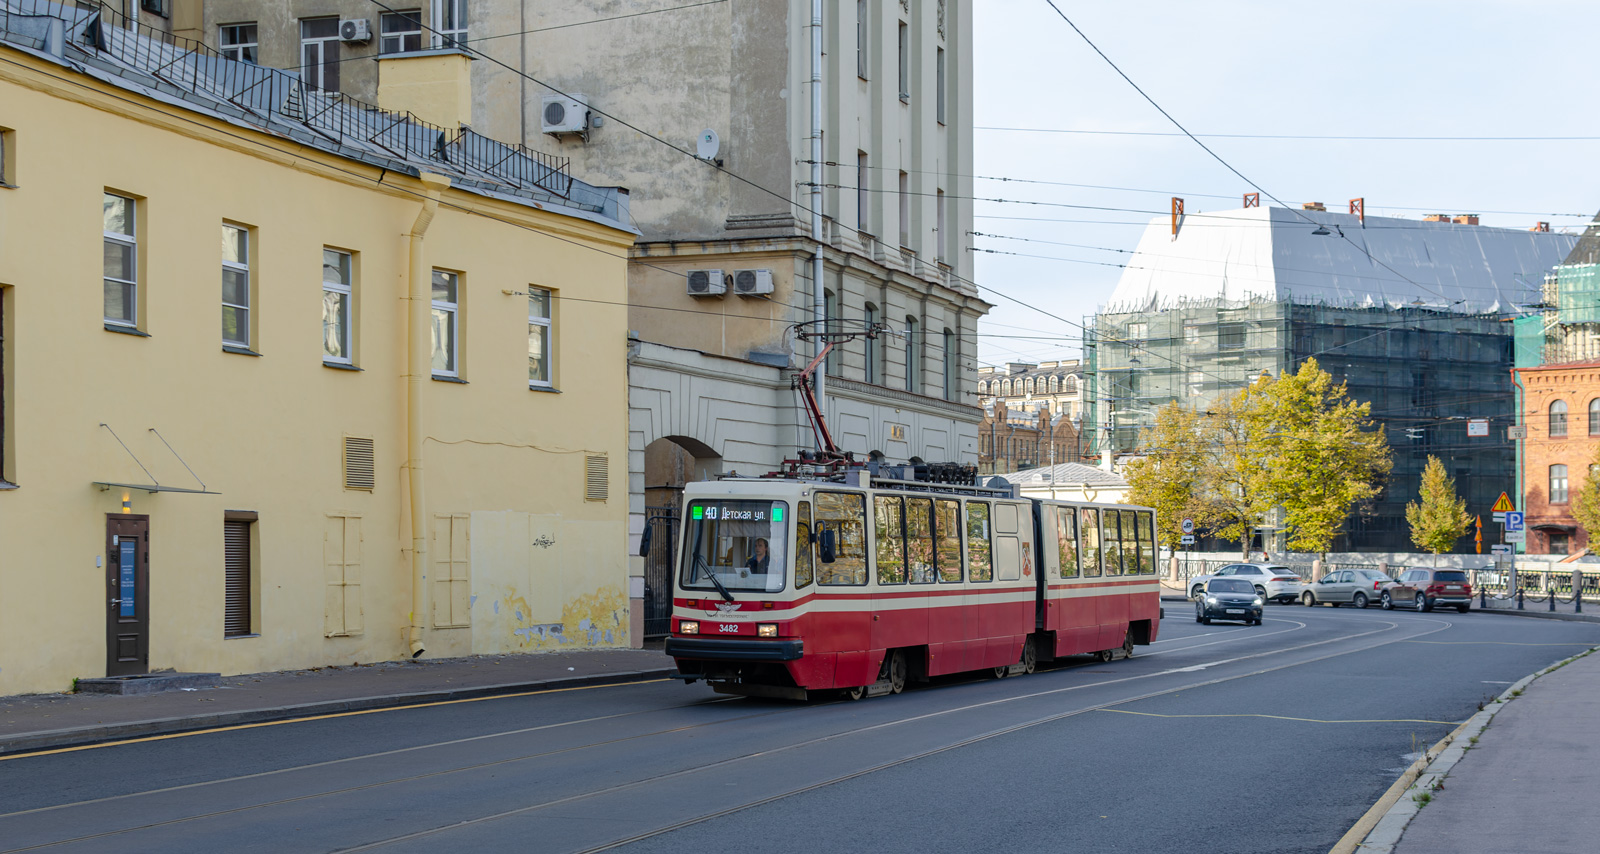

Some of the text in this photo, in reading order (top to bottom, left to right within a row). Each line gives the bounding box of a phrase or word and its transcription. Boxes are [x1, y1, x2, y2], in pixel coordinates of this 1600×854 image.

[705, 506, 766, 521] 40 Детская ул.
[1510, 513, 1521, 529] P
[718, 624, 739, 633] 3482
